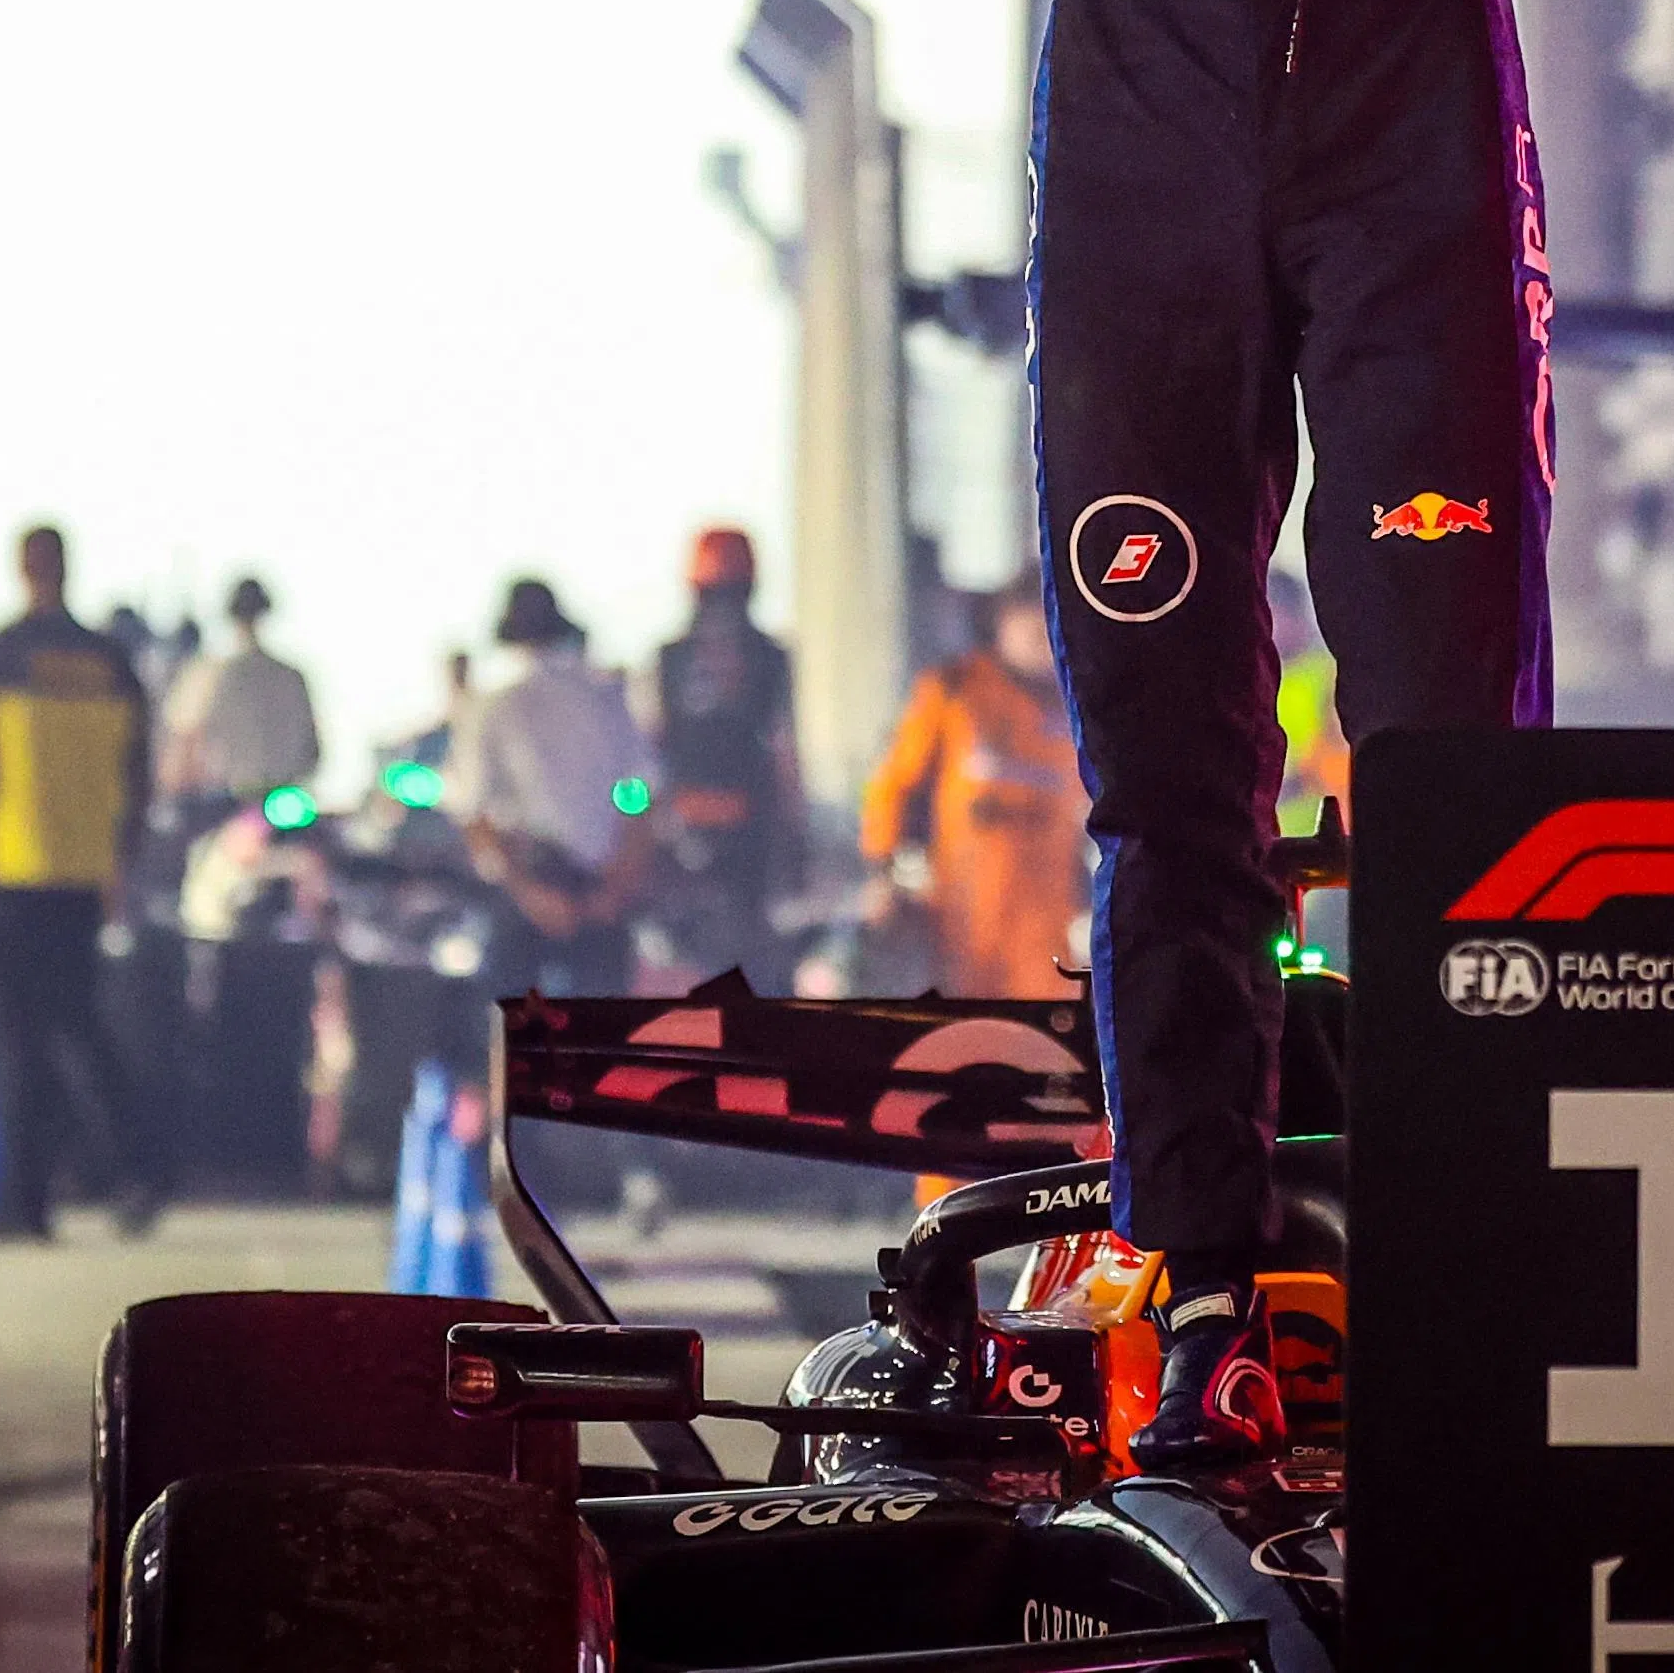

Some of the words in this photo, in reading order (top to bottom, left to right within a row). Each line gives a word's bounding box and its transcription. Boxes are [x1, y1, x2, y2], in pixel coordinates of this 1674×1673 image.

[1558, 953, 1608, 981] FIA
[1558, 984, 1654, 1011] World
[1026, 1179, 1113, 1214] DAM
